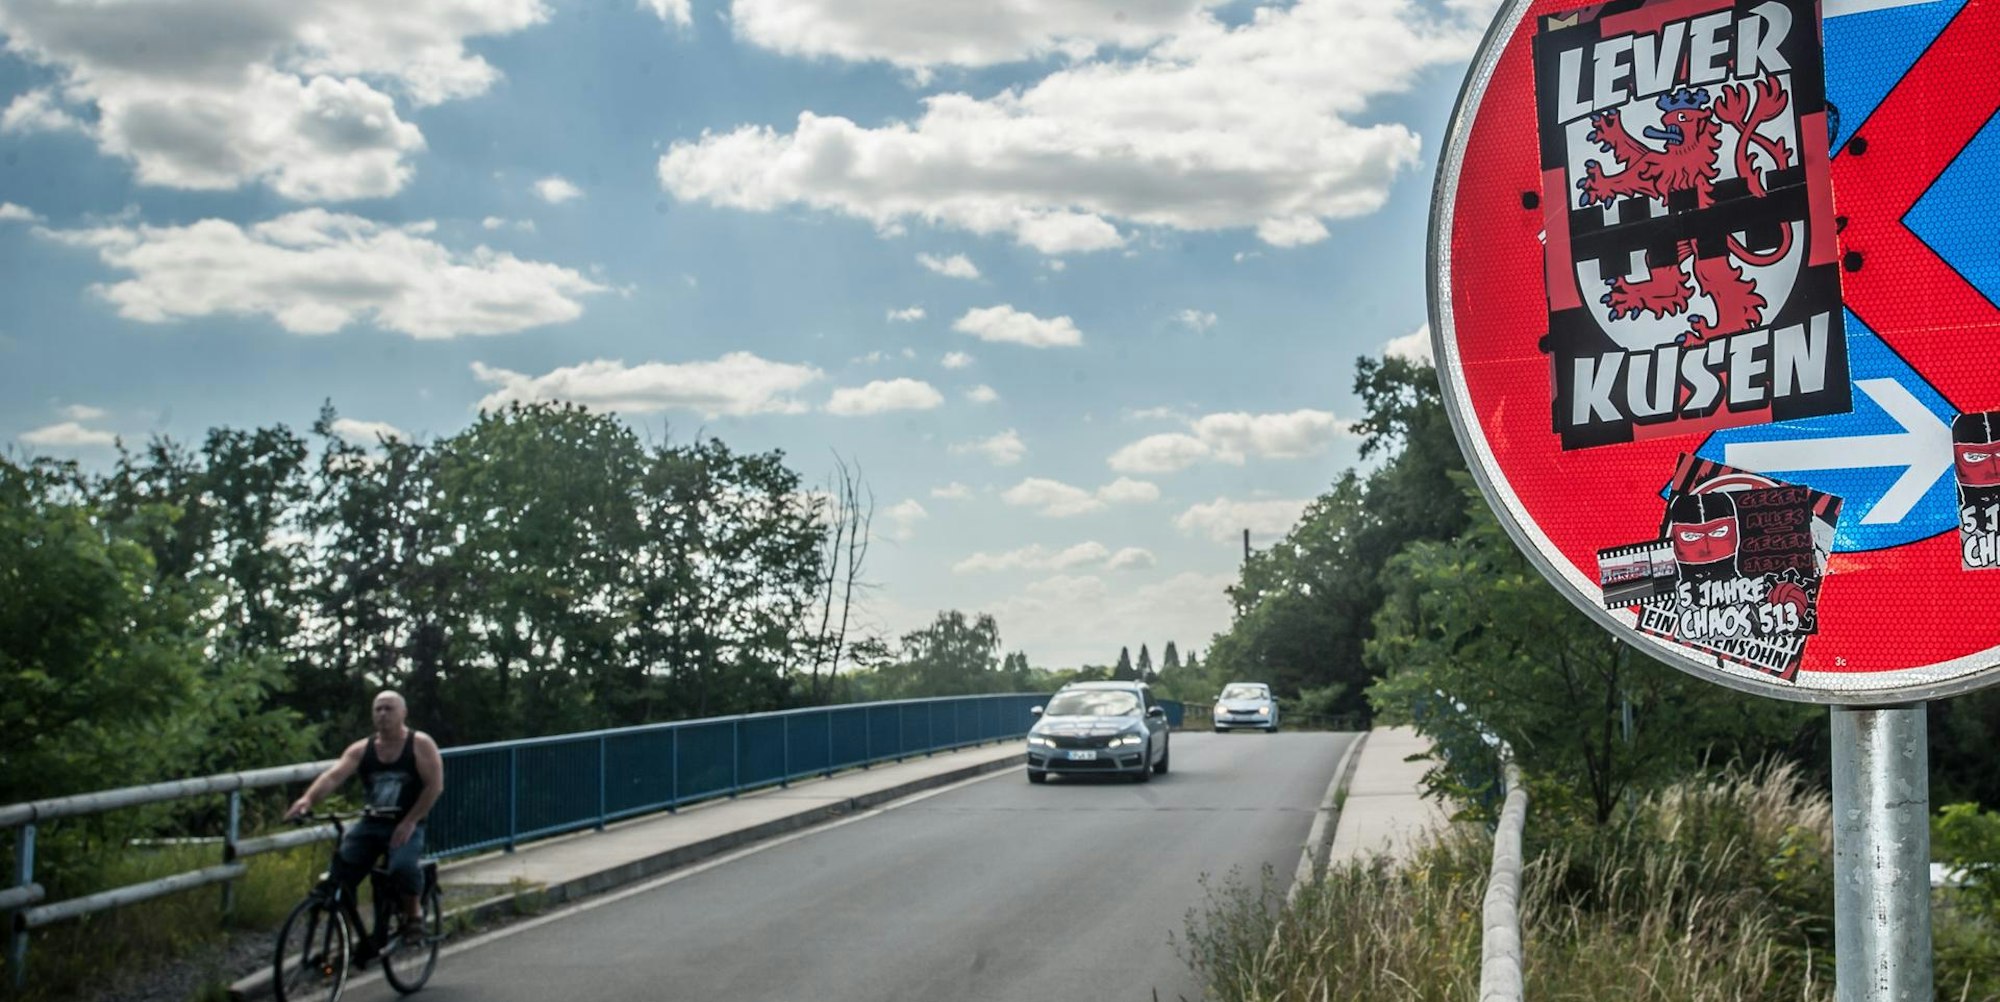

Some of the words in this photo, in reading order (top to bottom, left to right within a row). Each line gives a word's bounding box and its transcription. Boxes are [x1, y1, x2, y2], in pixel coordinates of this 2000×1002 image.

[1558, 1, 1793, 125] LEVER
[1572, 310, 1830, 426] KUSEN
[1737, 488, 1808, 509] GEGEN
[1746, 508, 1804, 529] ALLES
[1962, 505, 1977, 534] 5
[1741, 533, 1811, 553] GEGEN
[1964, 531, 2000, 568] CH
[1679, 582, 1693, 607] 5
[1699, 576, 1765, 607] JAHRE
[1681, 603, 1752, 639] CHAOS
[1759, 602, 1799, 634] 513
[1644, 609, 1676, 633] EIN
[1701, 639, 1788, 669] ENSOHN
